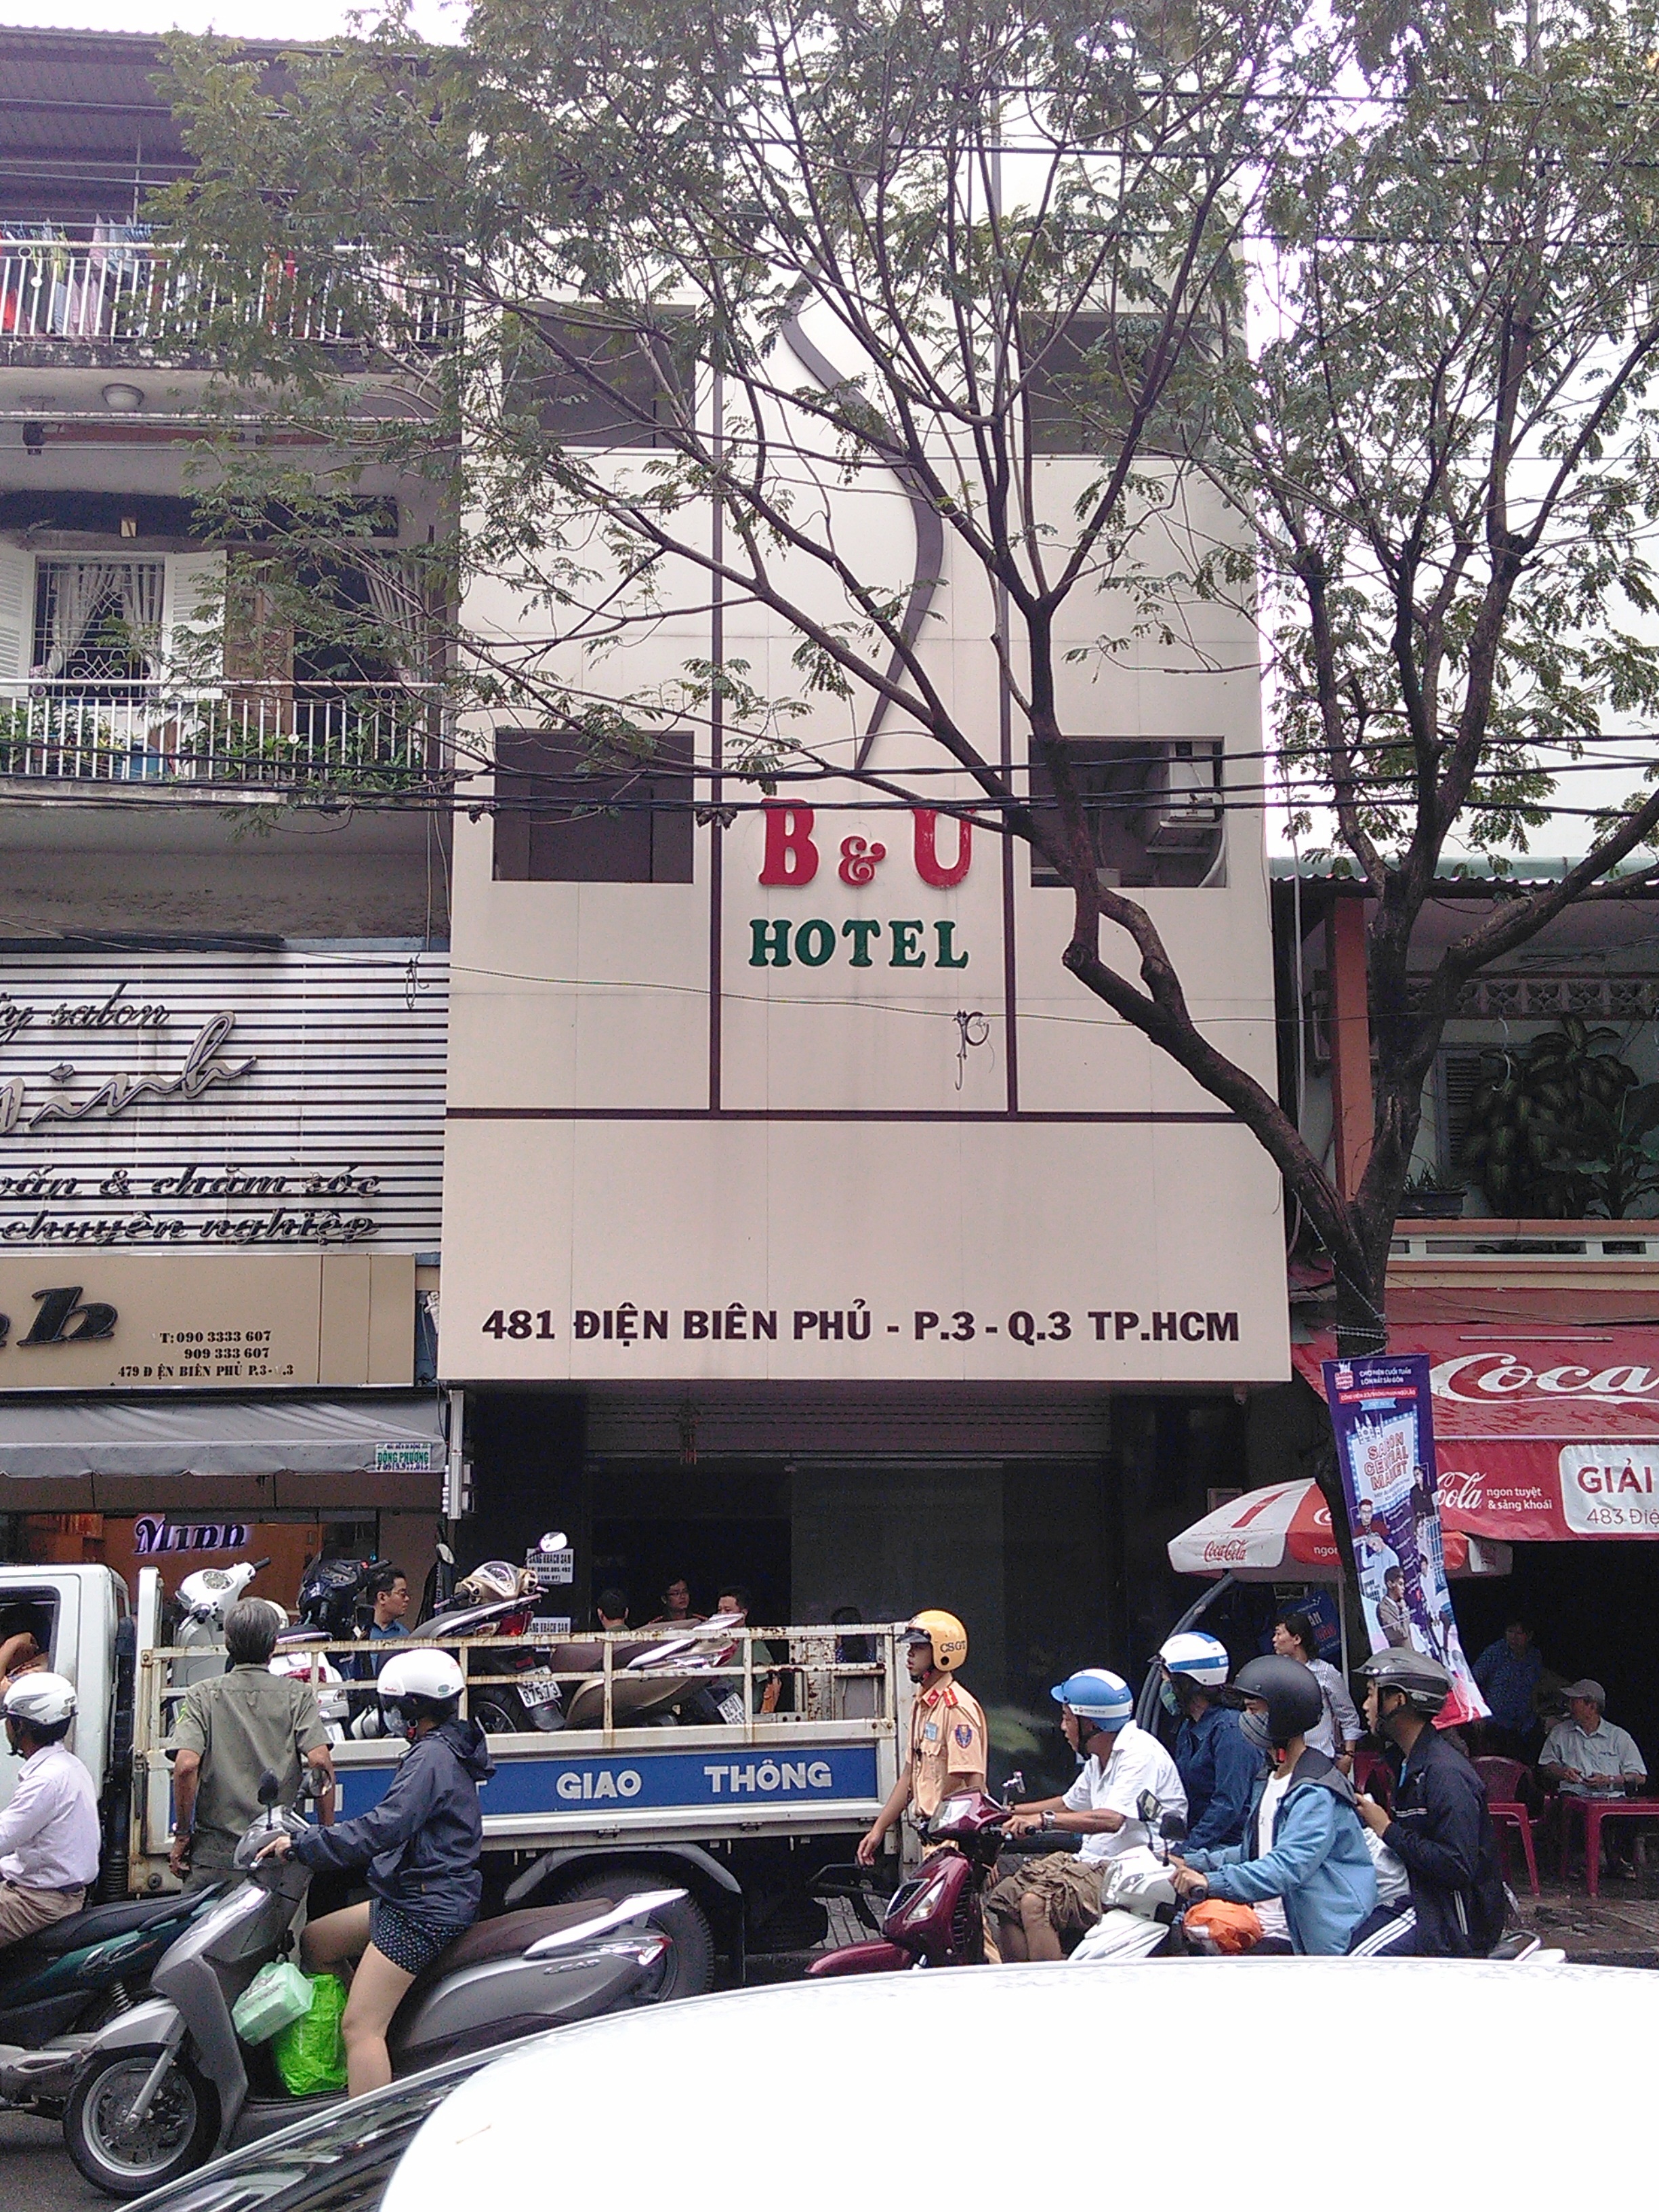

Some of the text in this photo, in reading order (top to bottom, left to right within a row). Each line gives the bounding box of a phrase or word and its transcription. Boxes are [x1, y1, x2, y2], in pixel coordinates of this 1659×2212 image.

[758, 798, 977, 888] B & U
[748, 919, 969, 969] HOTEL
[47, 982, 171, 1027] salon
[100, 1168, 131, 1195] &
[150, 1165, 292, 1198] chăm
[302, 1165, 381, 1198] sóc
[1, 1207, 380, 1246] chuyên nghiệp
[207, 1331, 241, 1343] 3333
[245, 1330, 272, 1342] 607
[482, 1309, 556, 1340] 481
[573, 1301, 669, 1347] ĐIỆN
[683, 1301, 777, 1340] BIÊN
[793, 1297, 872, 1340] PHỦ
[1088, 1311, 1240, 1342] TP.HCM
[214, 1347, 241, 1359] 333
[244, 1347, 270, 1359] 607
[118, 1366, 140, 1377] 479
[179, 1363, 211, 1376] BIÊN
[1577, 1457, 1653, 1494] GIẢI
[1486, 1487, 1542, 1498] ngon tuyệt
[1523, 1498, 1553, 1510] khoái
[1586, 1508, 1624, 1525] 483
[940, 1639, 966, 1654] CSGT
[556, 1759, 832, 1800] GIAO THÔNG
